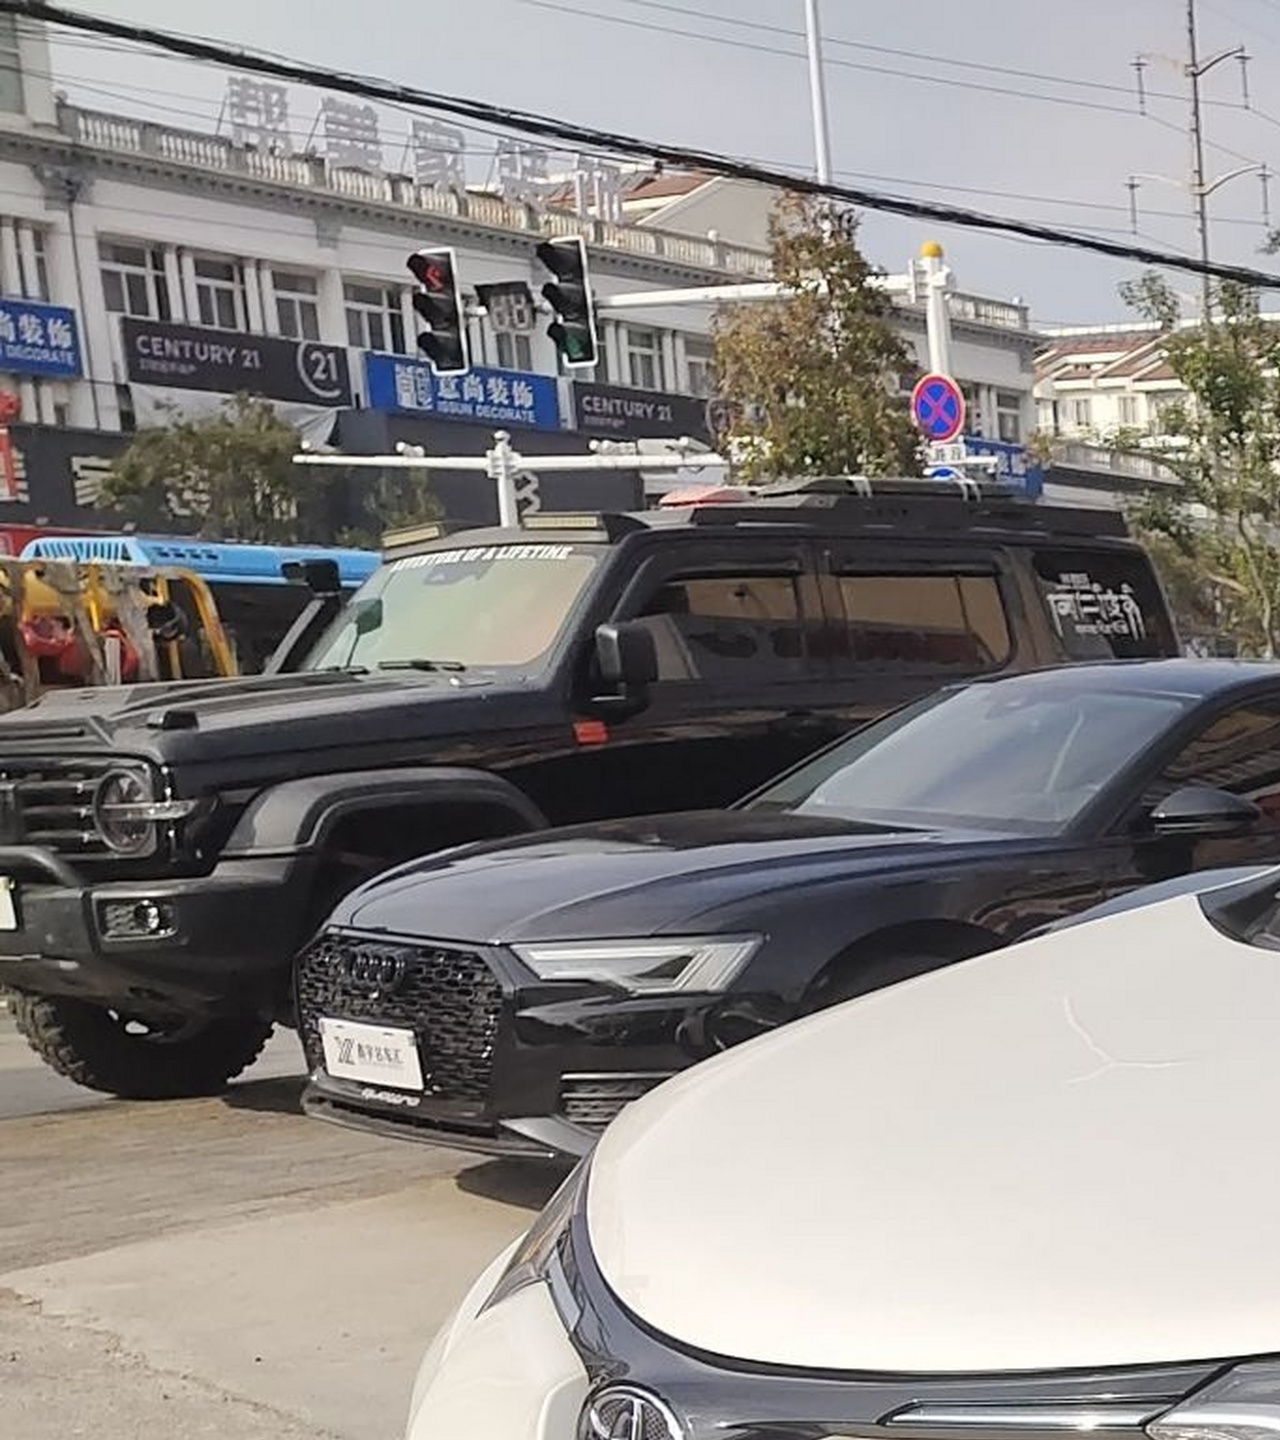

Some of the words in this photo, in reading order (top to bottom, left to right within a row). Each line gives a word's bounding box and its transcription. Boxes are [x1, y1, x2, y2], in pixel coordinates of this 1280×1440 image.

[136, 335, 237, 365] CENTURY
[241, 350, 261, 369] 21
[310, 350, 338, 381] 21
[475, 404, 536, 423] DECORATE
[582, 395, 655, 419] CENTURY
[657, 405, 673, 422] 21
